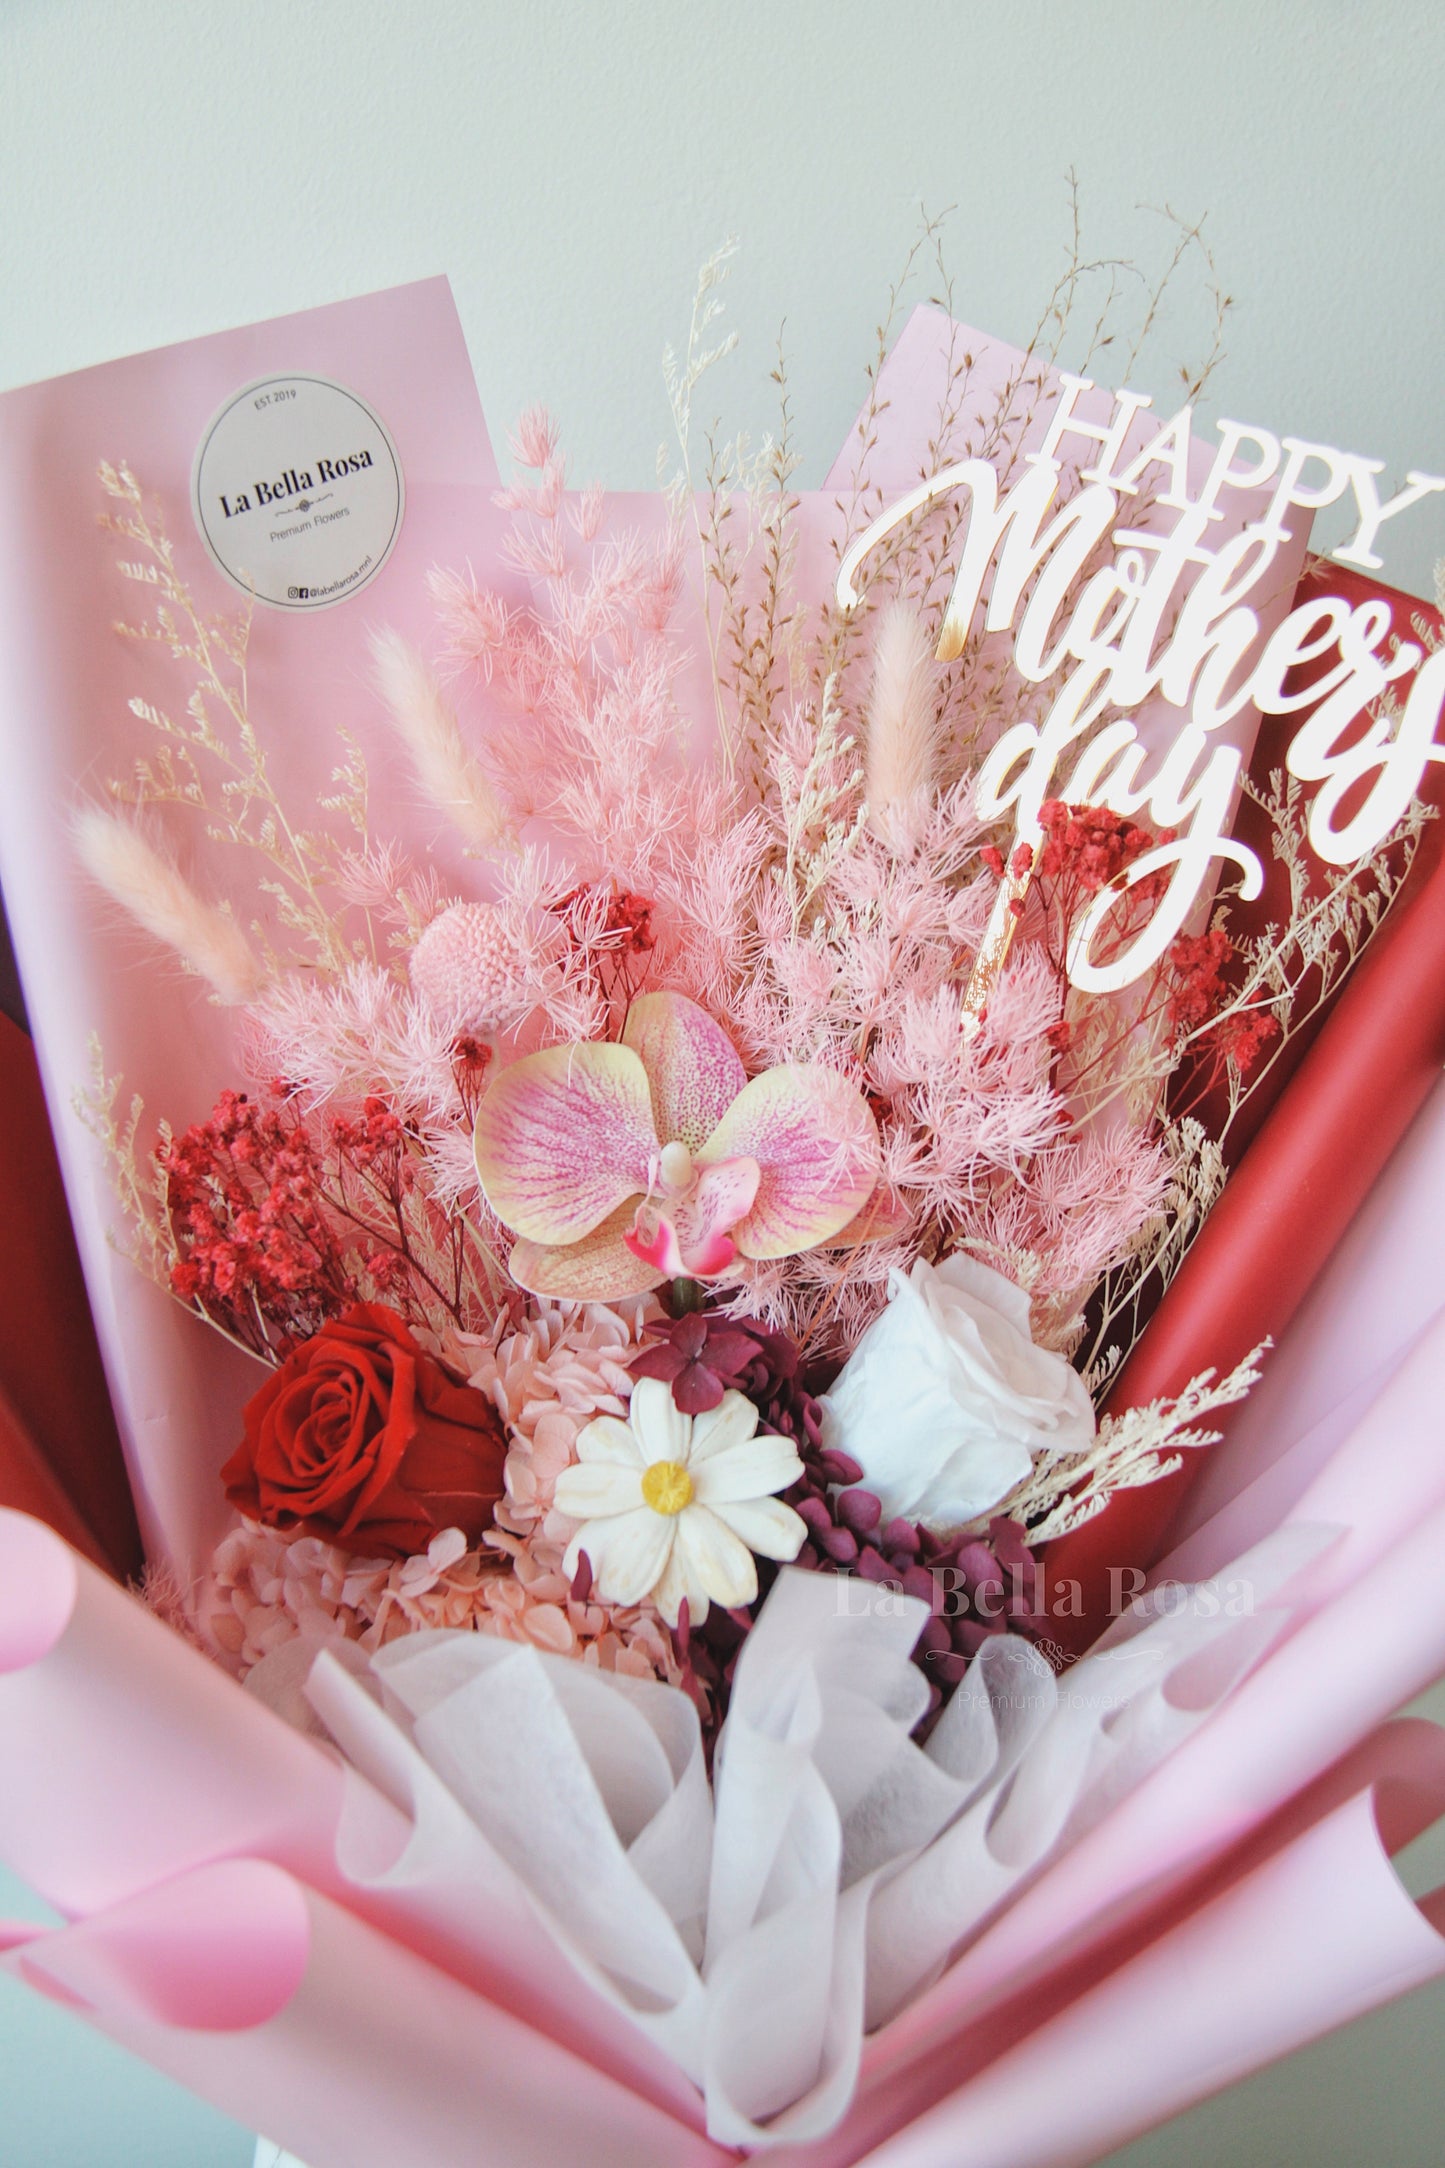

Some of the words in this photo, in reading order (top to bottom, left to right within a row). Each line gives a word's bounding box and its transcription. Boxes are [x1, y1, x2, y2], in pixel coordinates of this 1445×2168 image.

[273, 389, 297, 402] 2019
[219, 495, 251, 518] La
[253, 469, 314, 506] Bella
[316, 449, 374, 484] Rosa
[1026, 373, 1445, 569] HAPPY
[270, 519, 312, 542] Premium
[313, 507, 350, 526] Flowers
[974, 650, 1264, 994] day
